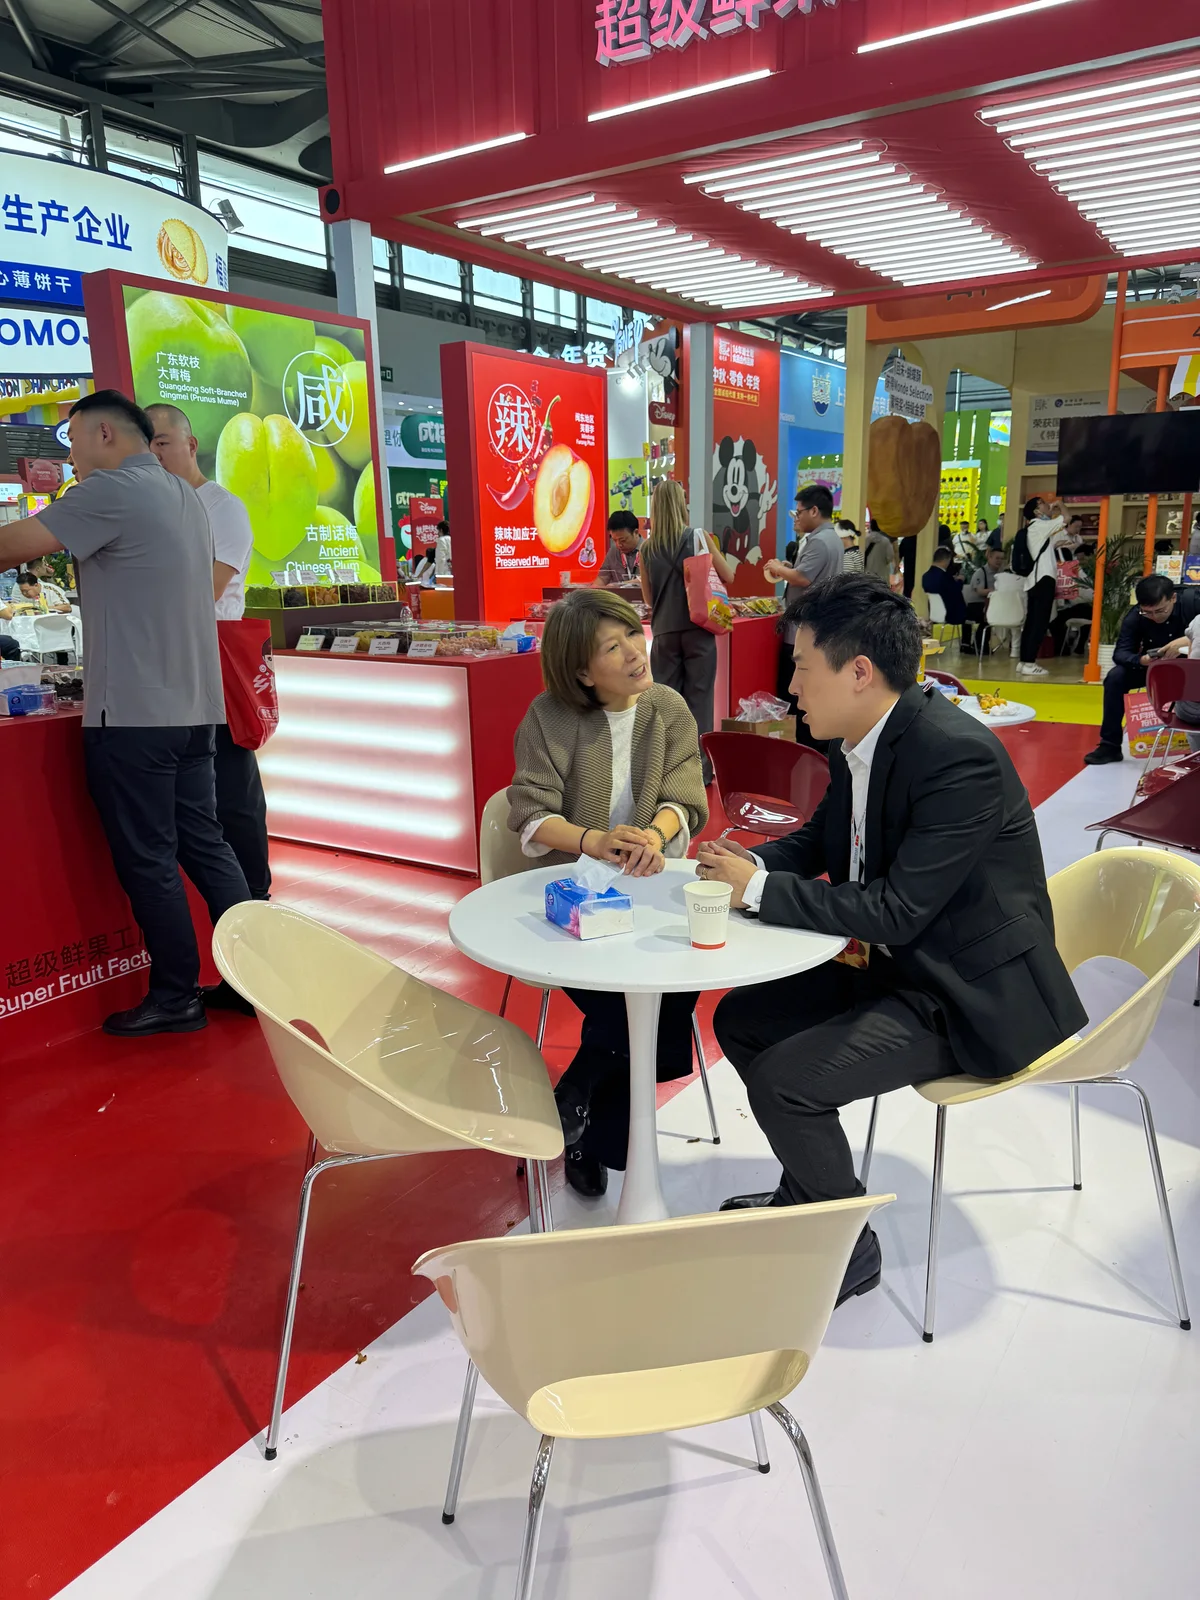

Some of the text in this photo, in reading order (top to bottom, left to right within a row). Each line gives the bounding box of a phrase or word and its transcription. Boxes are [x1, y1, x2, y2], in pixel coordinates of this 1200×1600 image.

[2, 194, 132, 251] 生产企业
[156, 352, 200, 370] 广东软枝
[158, 367, 191, 383] 大青梅
[158, 381, 248, 399] Guangdong Soft-Branched
[297, 364, 349, 433] 咸
[909, 385, 933, 402] Selection
[159, 391, 239, 408] Qingmei (Prunus Mume)
[494, 393, 533, 453] 辣
[305, 524, 359, 542] 古制话梅
[494, 526, 538, 541] 辣味加应子
[319, 545, 359, 557] Ancient
[495, 543, 516, 556] Spicy
[496, 556, 550, 567] Preserved Plum
[59, 964, 104, 993] Fruit
